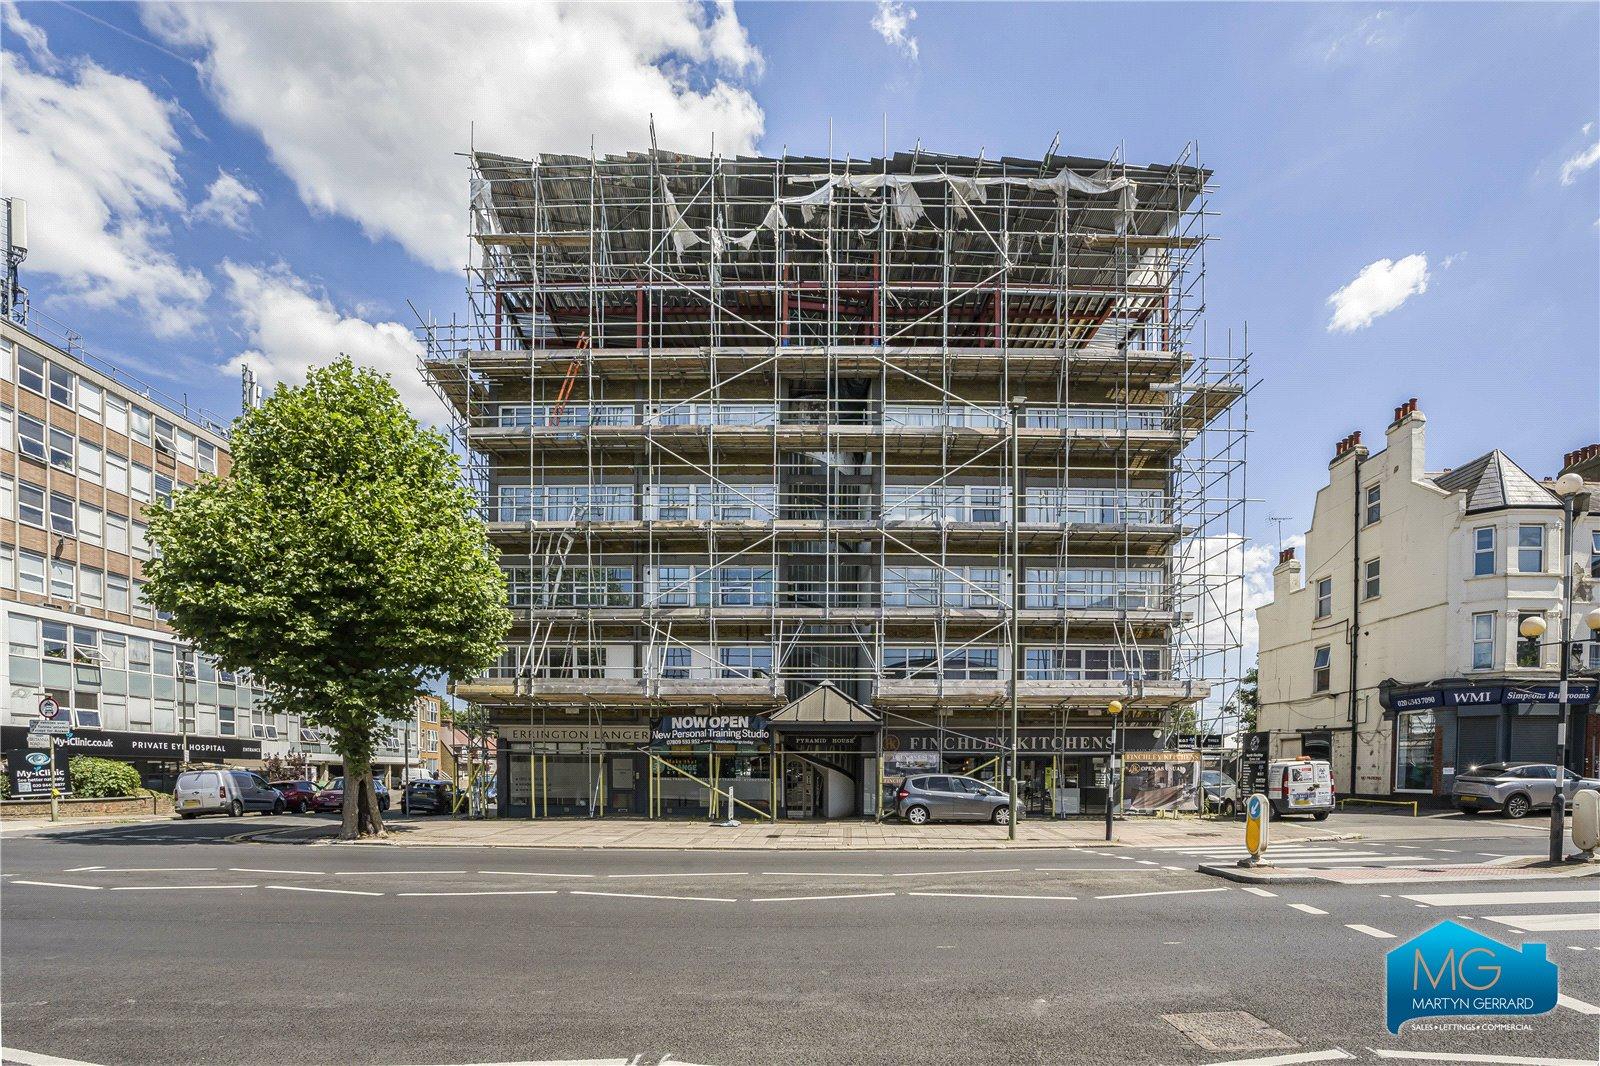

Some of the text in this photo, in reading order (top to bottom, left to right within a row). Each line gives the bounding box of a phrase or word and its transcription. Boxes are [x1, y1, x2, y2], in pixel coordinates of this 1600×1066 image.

[1453, 691, 1491, 703] WMI
[1507, 691, 1590, 701] Simpsons Batrooms
[671, 716, 749, 729] NOW OPEN
[512, 729, 649, 740] ERRINGTON LANGER
[652, 728, 770, 739] New Personal Training Studio
[132, 741, 226, 752] PRIVATE EYE HOSPITAL
[910, 736, 1113, 750] FINCHLEY KITCHENS
[16, 768, 65, 779] My-iCliic
